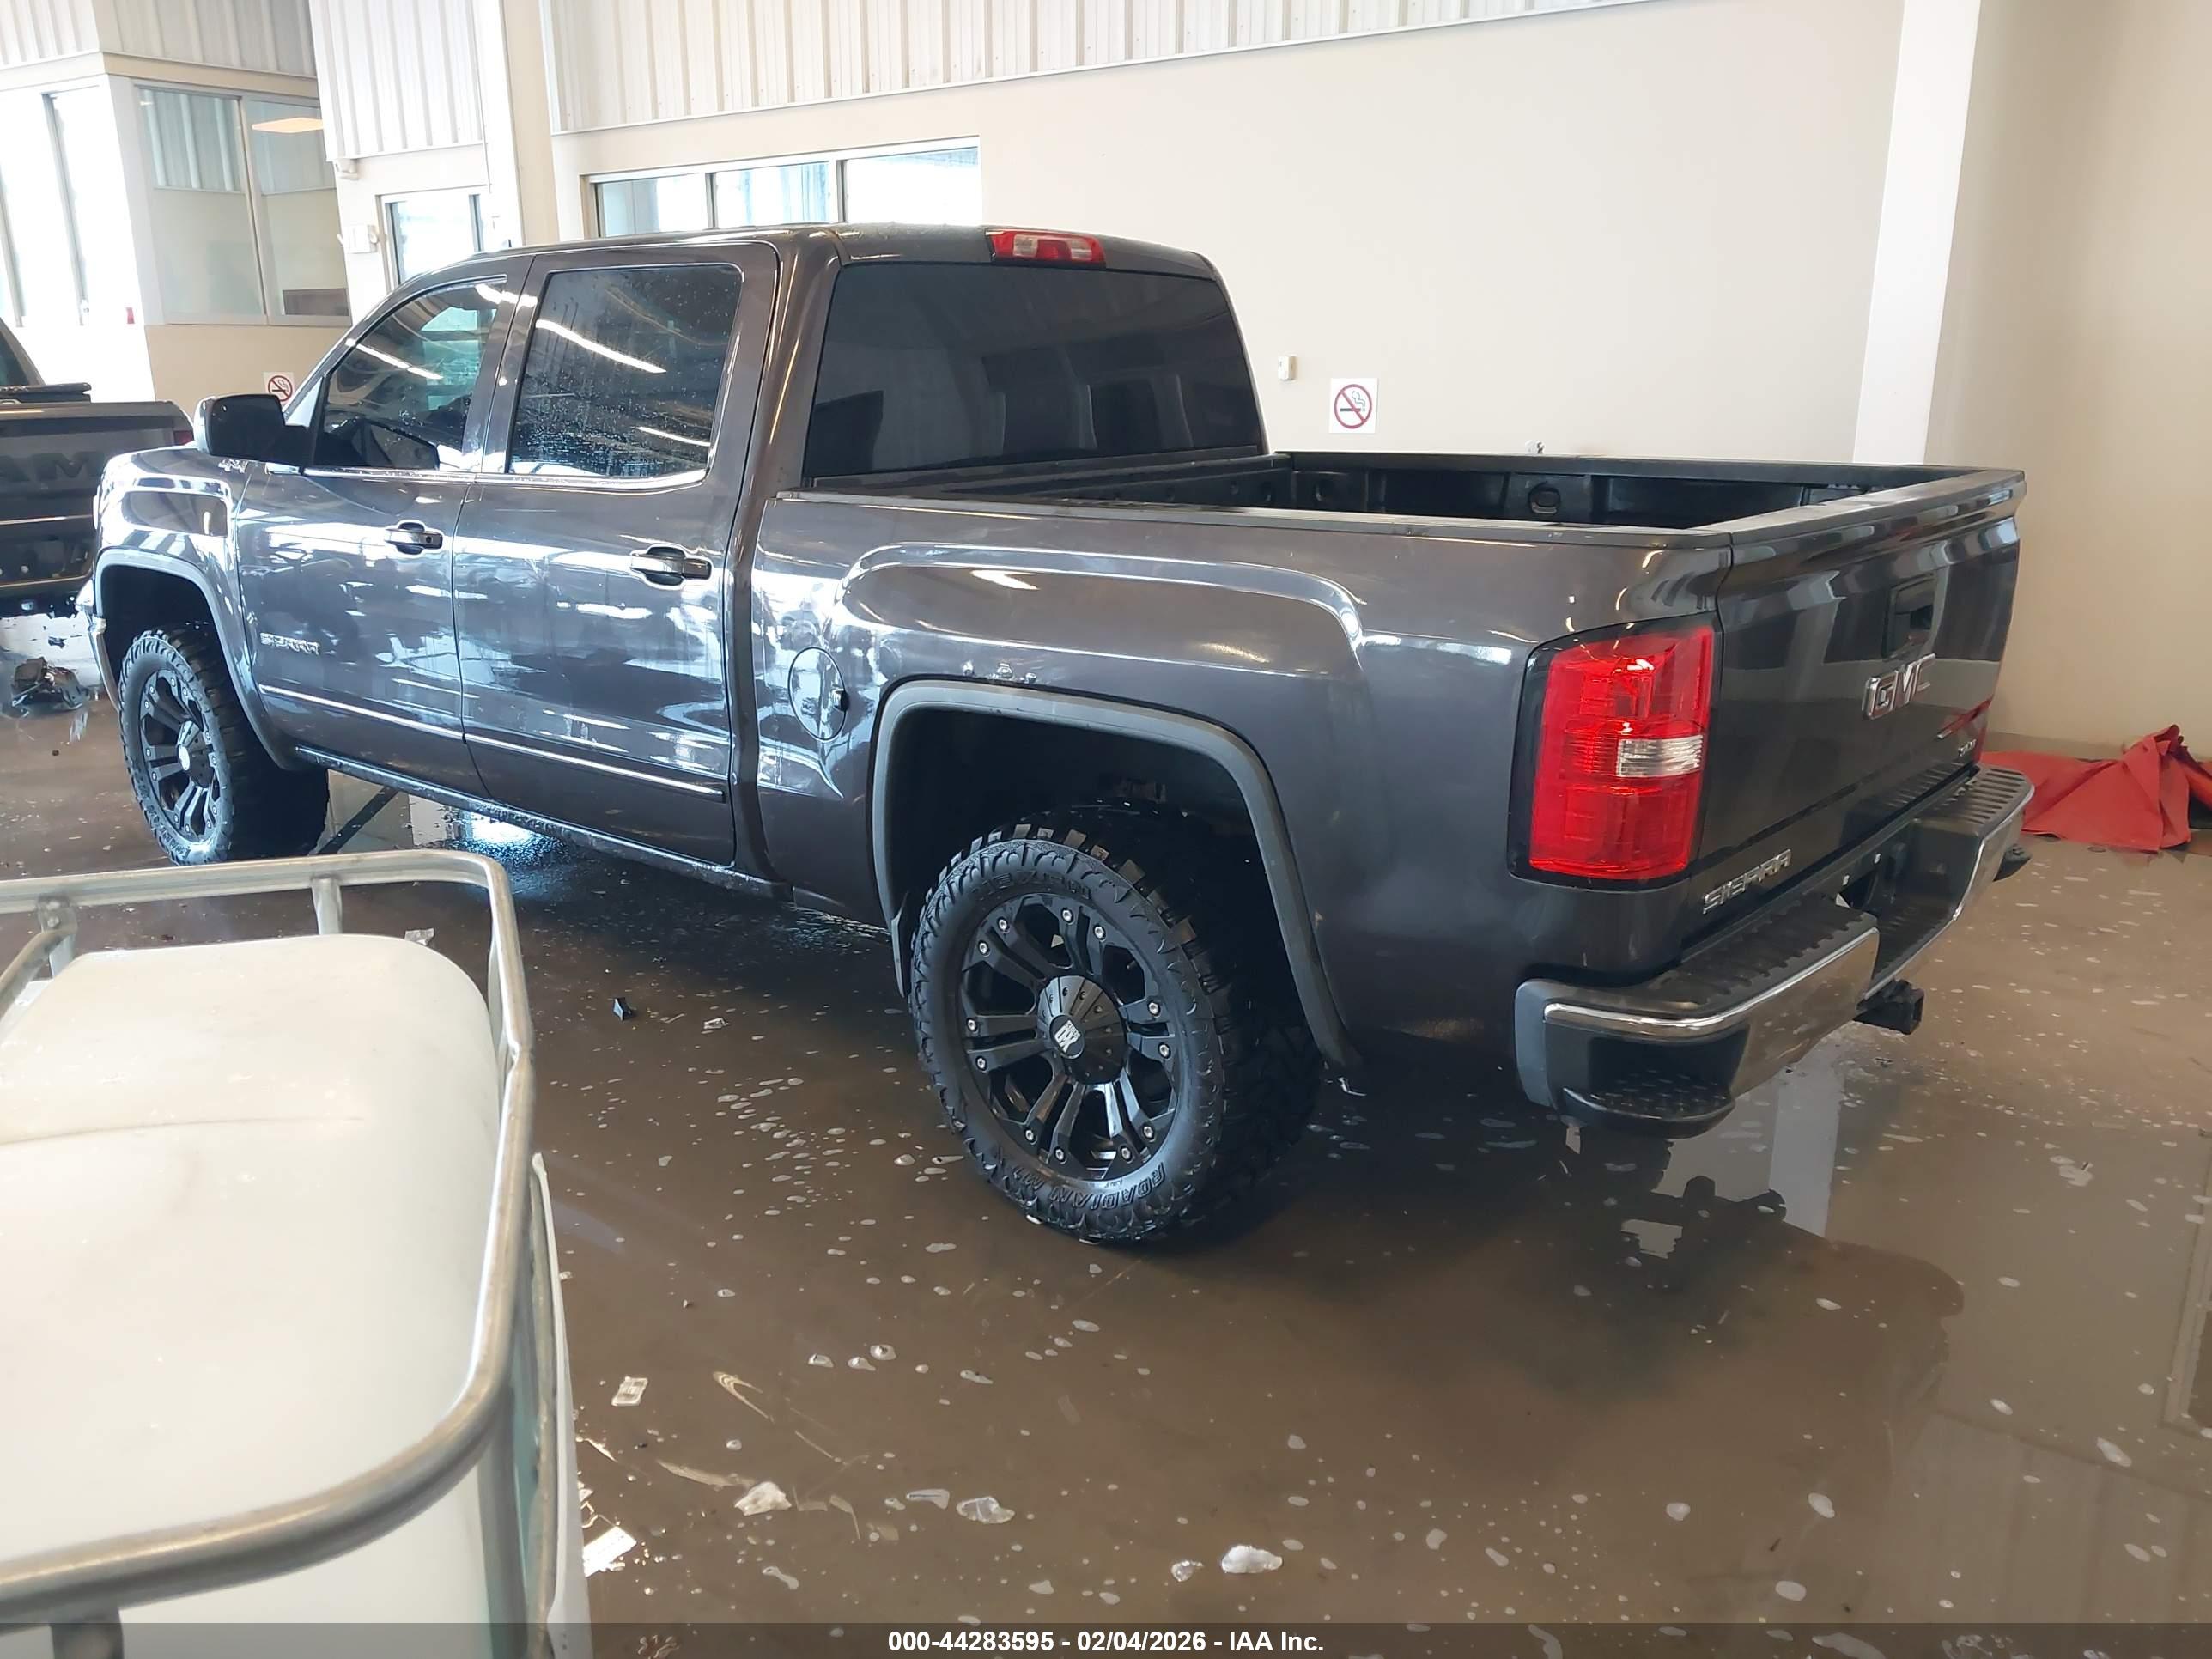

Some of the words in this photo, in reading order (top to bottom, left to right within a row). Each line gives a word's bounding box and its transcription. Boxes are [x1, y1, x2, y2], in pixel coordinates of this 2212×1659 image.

[1862, 653, 1936, 720] GMC
[1703, 848, 1792, 915] SIERRA
[1048, 1163, 1165, 1210] ROADIAN
